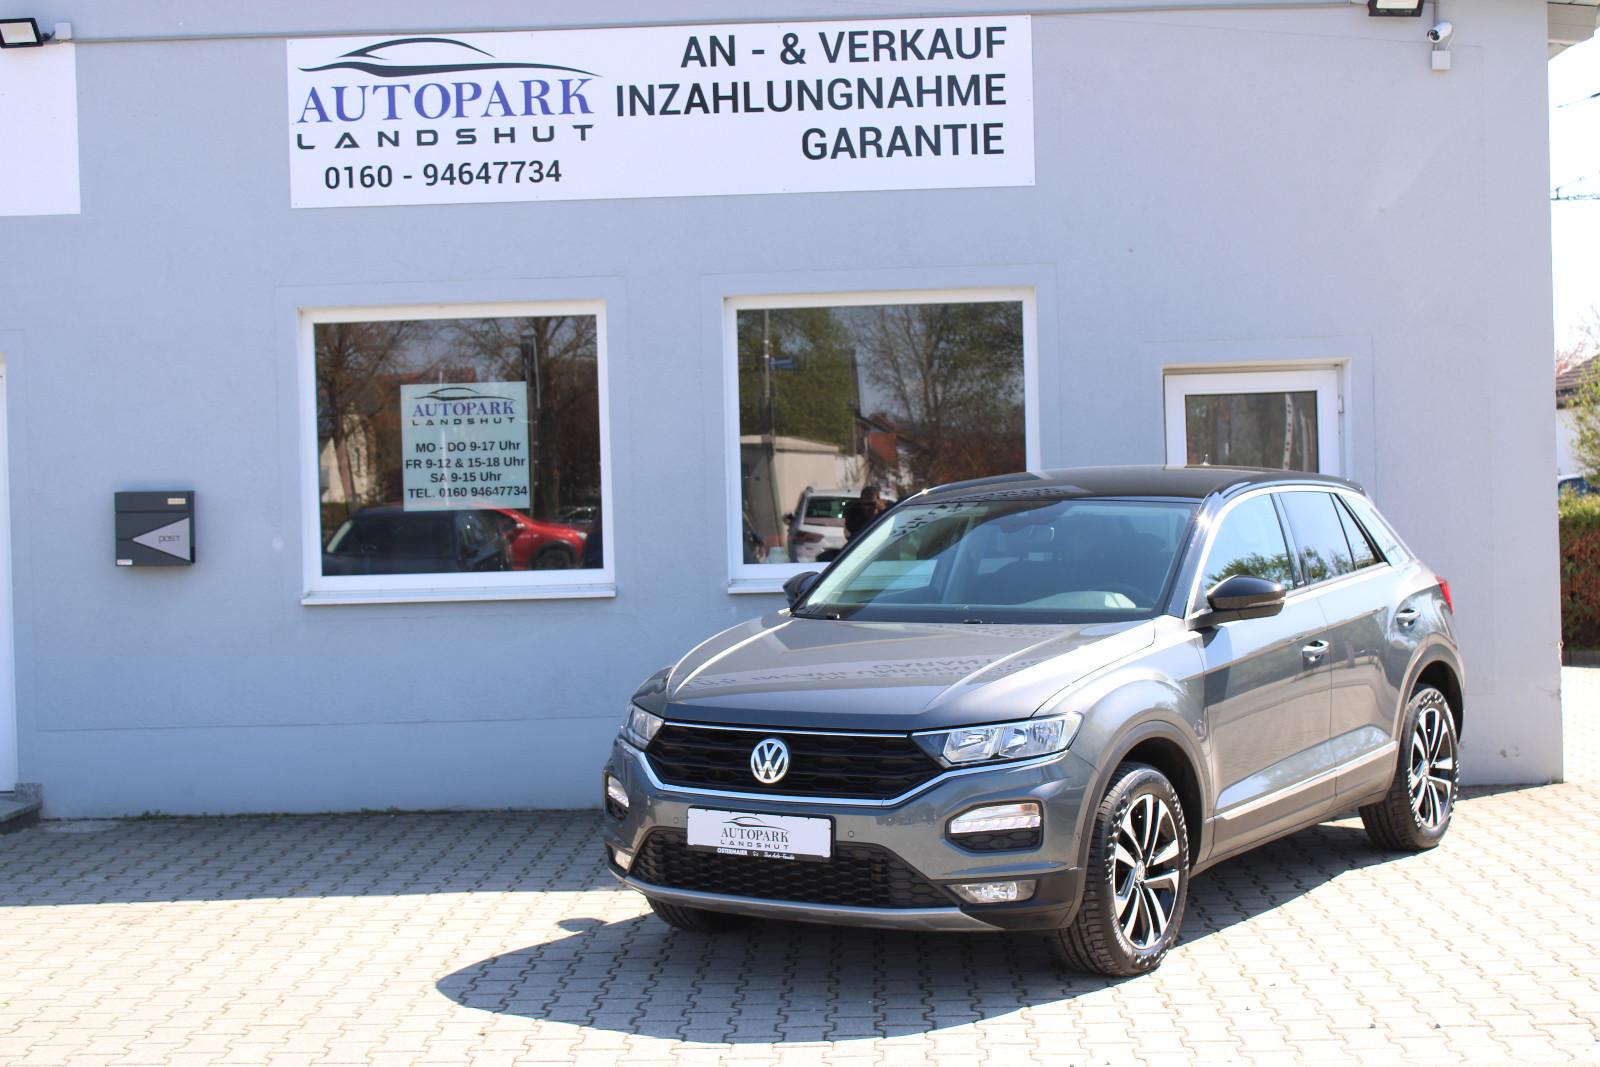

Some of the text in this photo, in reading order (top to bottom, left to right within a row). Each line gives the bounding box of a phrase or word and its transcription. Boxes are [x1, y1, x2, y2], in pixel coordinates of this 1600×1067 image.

[680, 35, 736, 68] AN
[779, 32, 806, 64] &
[818, 26, 1007, 63] VERKAUF
[297, 78, 594, 123] AUTOPARK
[616, 73, 1007, 116] INZAHLUNGNAHME
[297, 124, 594, 150] LANDSHUT
[802, 122, 1005, 160] GARANTIE
[324, 165, 393, 189] 0160
[423, 159, 562, 186] 94647734
[412, 401, 514, 417] AUTOPARK
[412, 417, 515, 426] LANDSHUT
[416, 442, 436, 453] MO
[448, 441, 466, 452] DO
[470, 441, 495, 451] 9-17
[499, 440, 521, 451] Uhr
[405, 456, 526, 469] FR 9-12 & 15-18 Uhr
[430, 471, 502, 483] SA 9-15 Uhr
[408, 486, 528, 498] TEL. 0160 94647734
[721, 827, 789, 843] AUTOPARK
[720, 839, 790, 850] LANDSHUT
